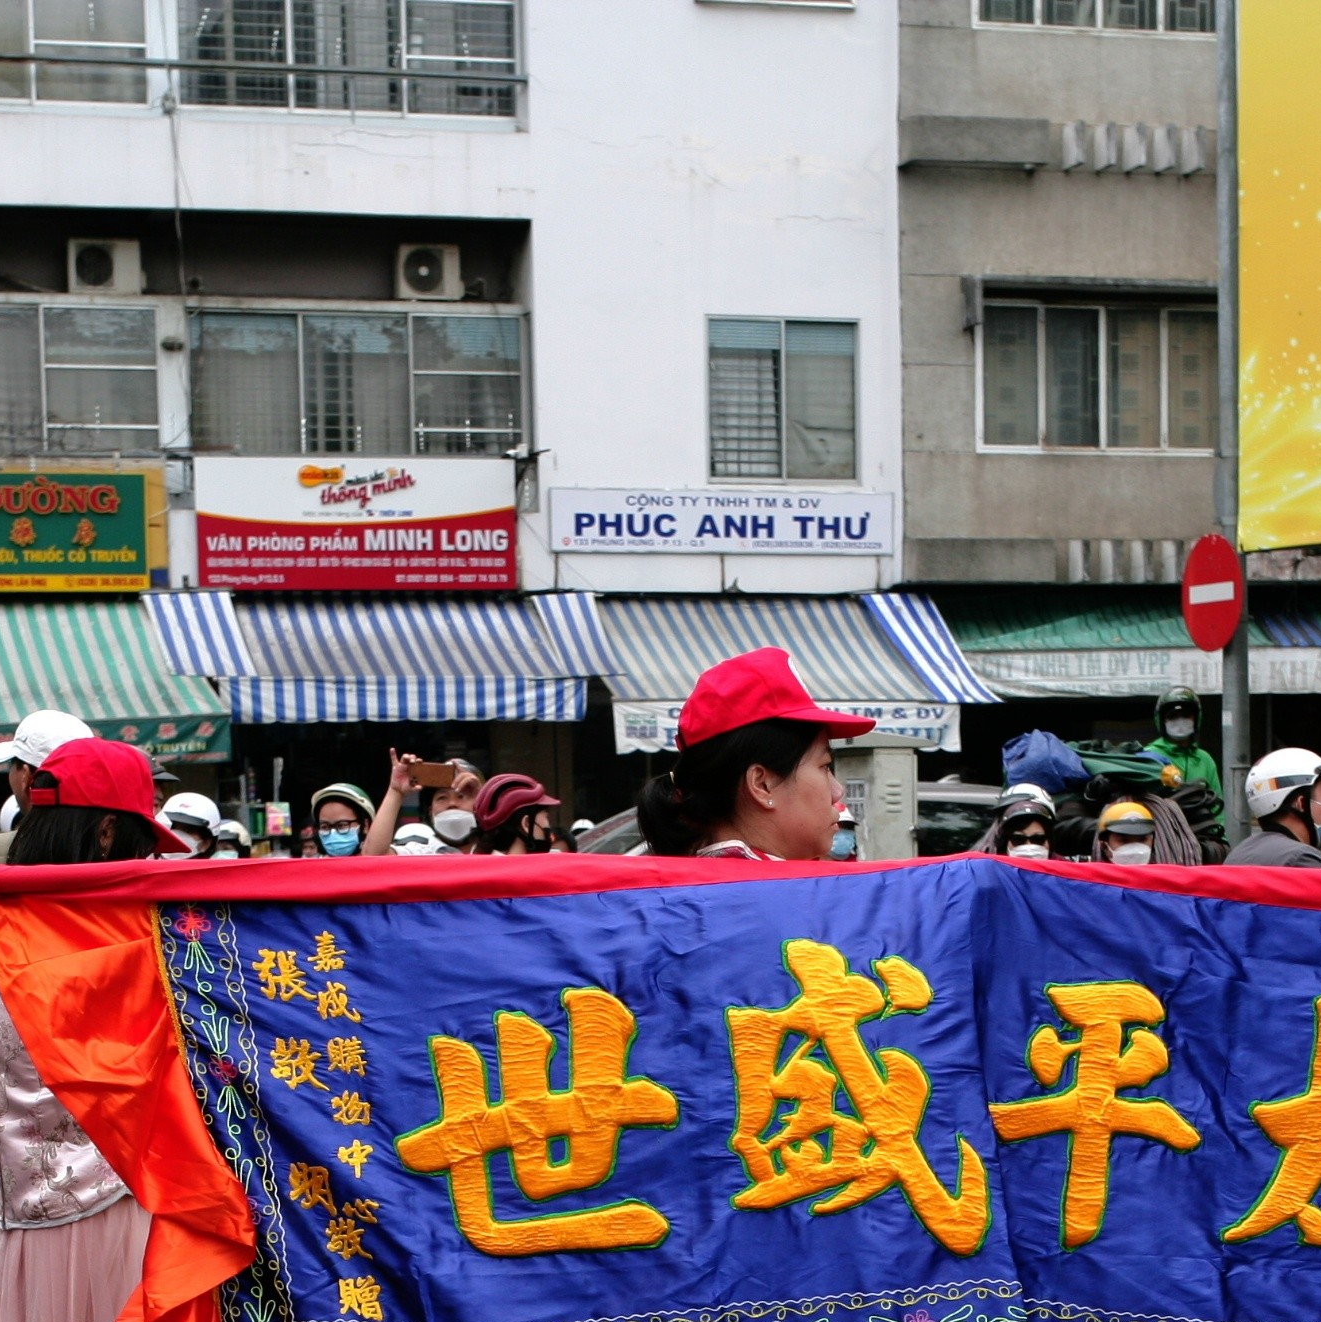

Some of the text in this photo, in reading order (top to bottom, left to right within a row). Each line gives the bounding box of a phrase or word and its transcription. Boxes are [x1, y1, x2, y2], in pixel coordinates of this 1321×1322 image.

[320, 468, 416, 509] thông minh
[626, 494, 821, 509] CÔNG TY TNHH TM & DV
[574, 507, 870, 540] PHÚC ANH THƯ
[206, 529, 509, 552] VĂN PHÒNG PHẨM MINH LONG
[22, 546, 65, 562] THUỐC
[892, 707, 907, 719] &
[918, 708, 945, 719] DV
